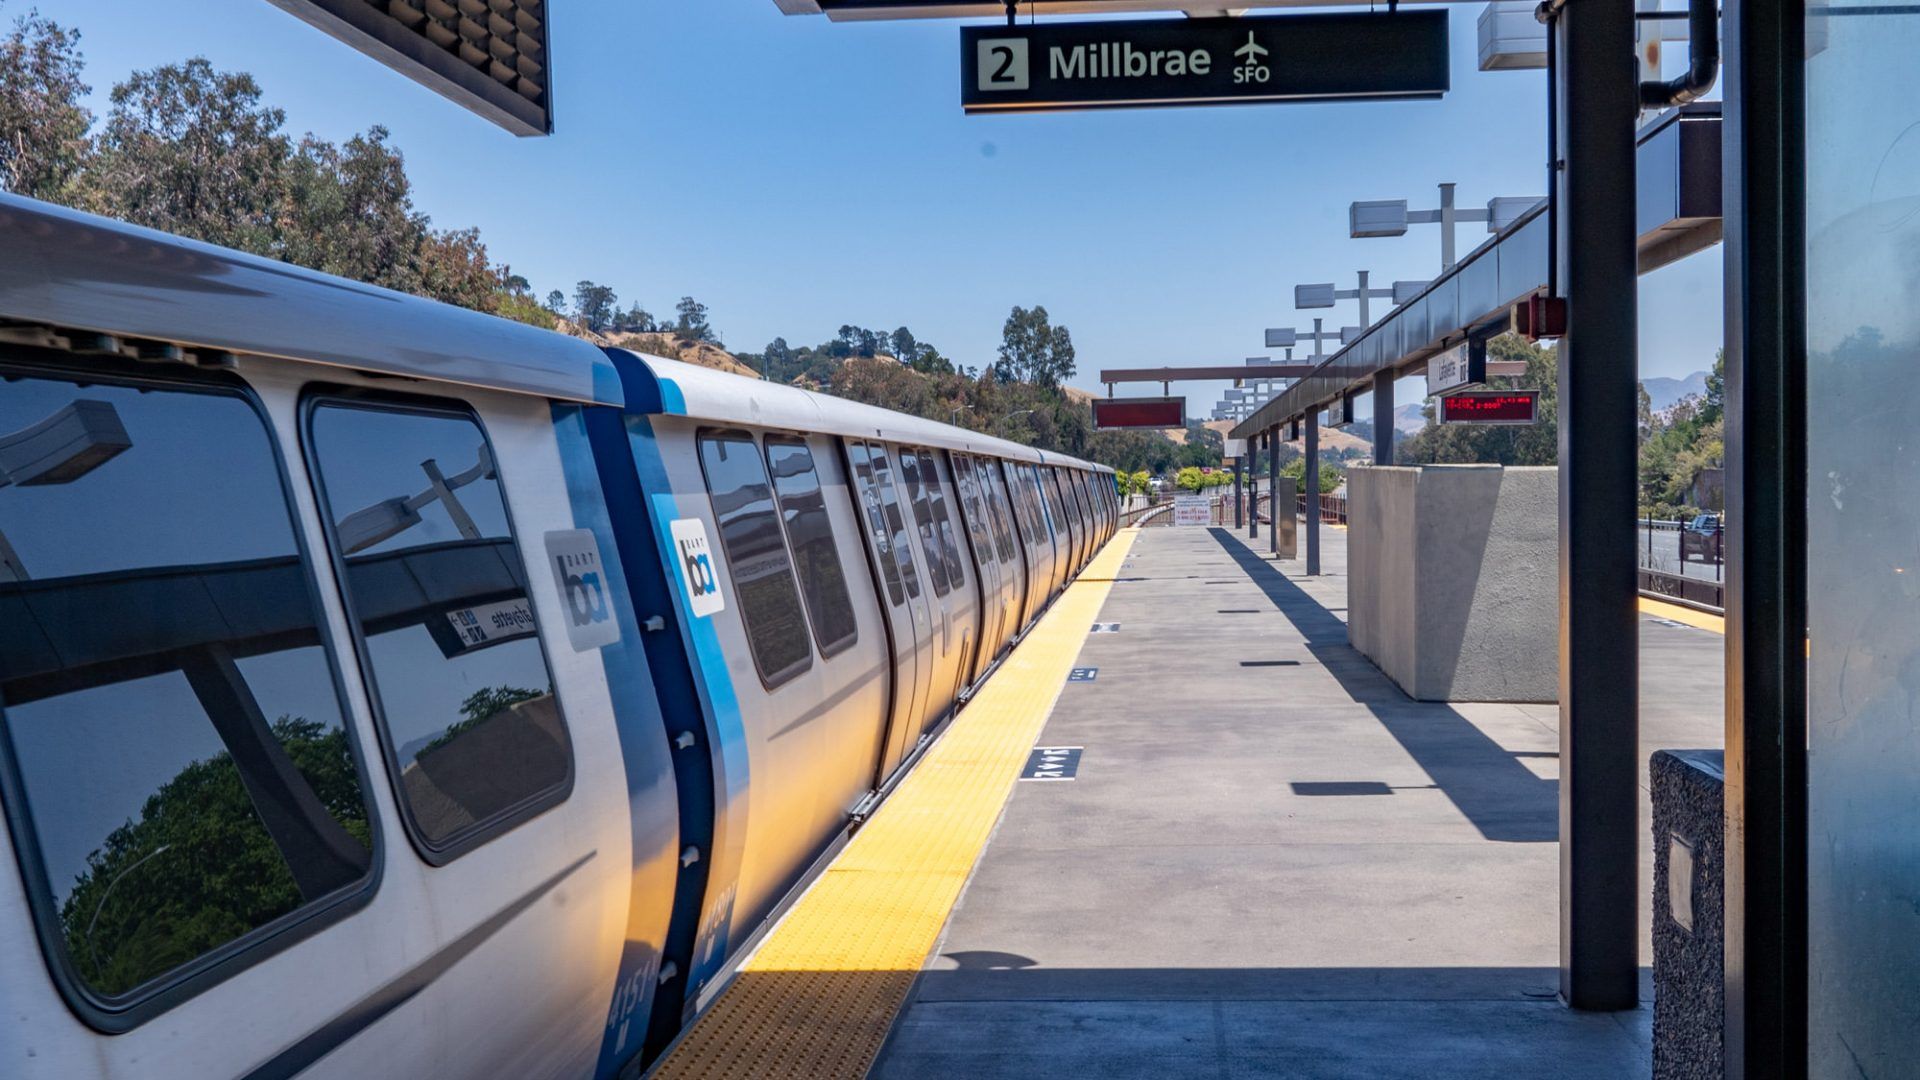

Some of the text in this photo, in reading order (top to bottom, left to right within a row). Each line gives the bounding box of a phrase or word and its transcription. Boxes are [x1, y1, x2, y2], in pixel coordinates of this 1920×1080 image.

[990, 42, 1211, 83] 2 Millbrae
[1233, 66, 1270, 84] SFO
[686, 537, 705, 550] BART
[567, 552, 594, 568] BART
